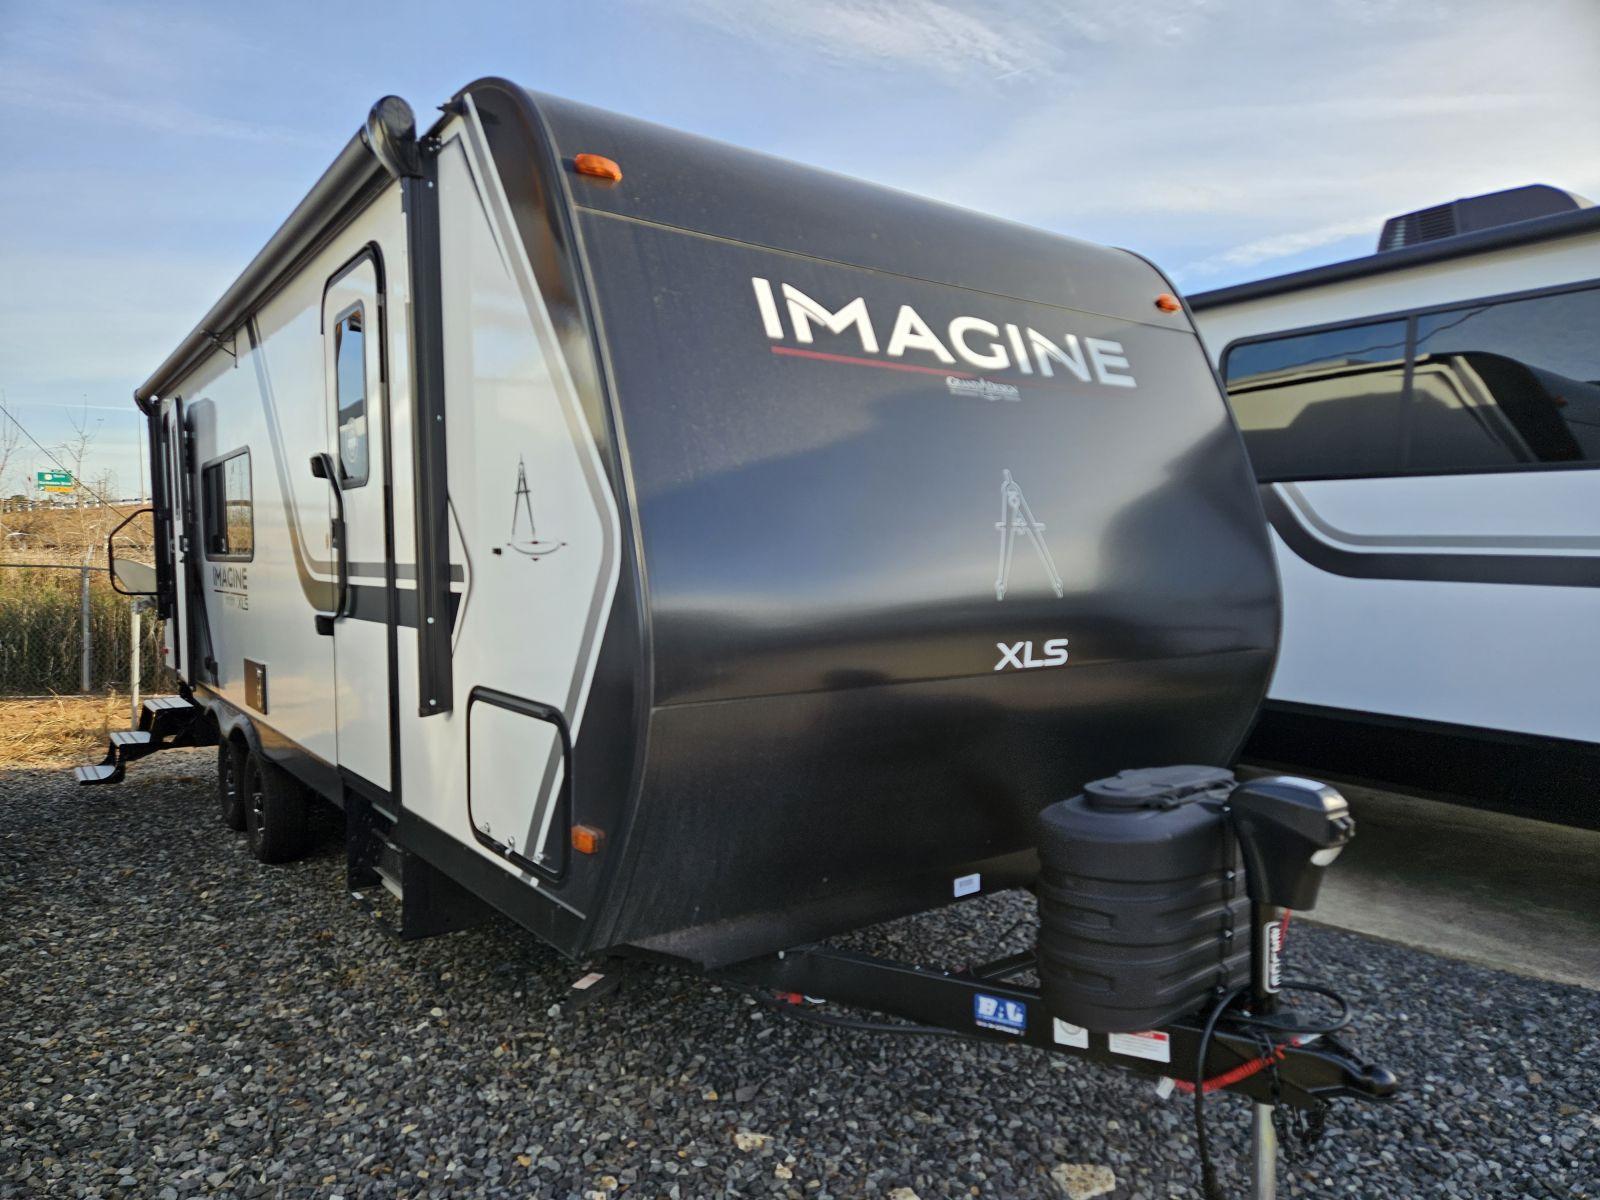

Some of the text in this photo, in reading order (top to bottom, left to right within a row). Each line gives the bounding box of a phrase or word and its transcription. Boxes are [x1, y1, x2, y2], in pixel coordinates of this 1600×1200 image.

[752, 277, 1138, 388] IMAGINE
[212, 566, 248, 590] IMAGINE
[994, 638, 1069, 671] XLS
